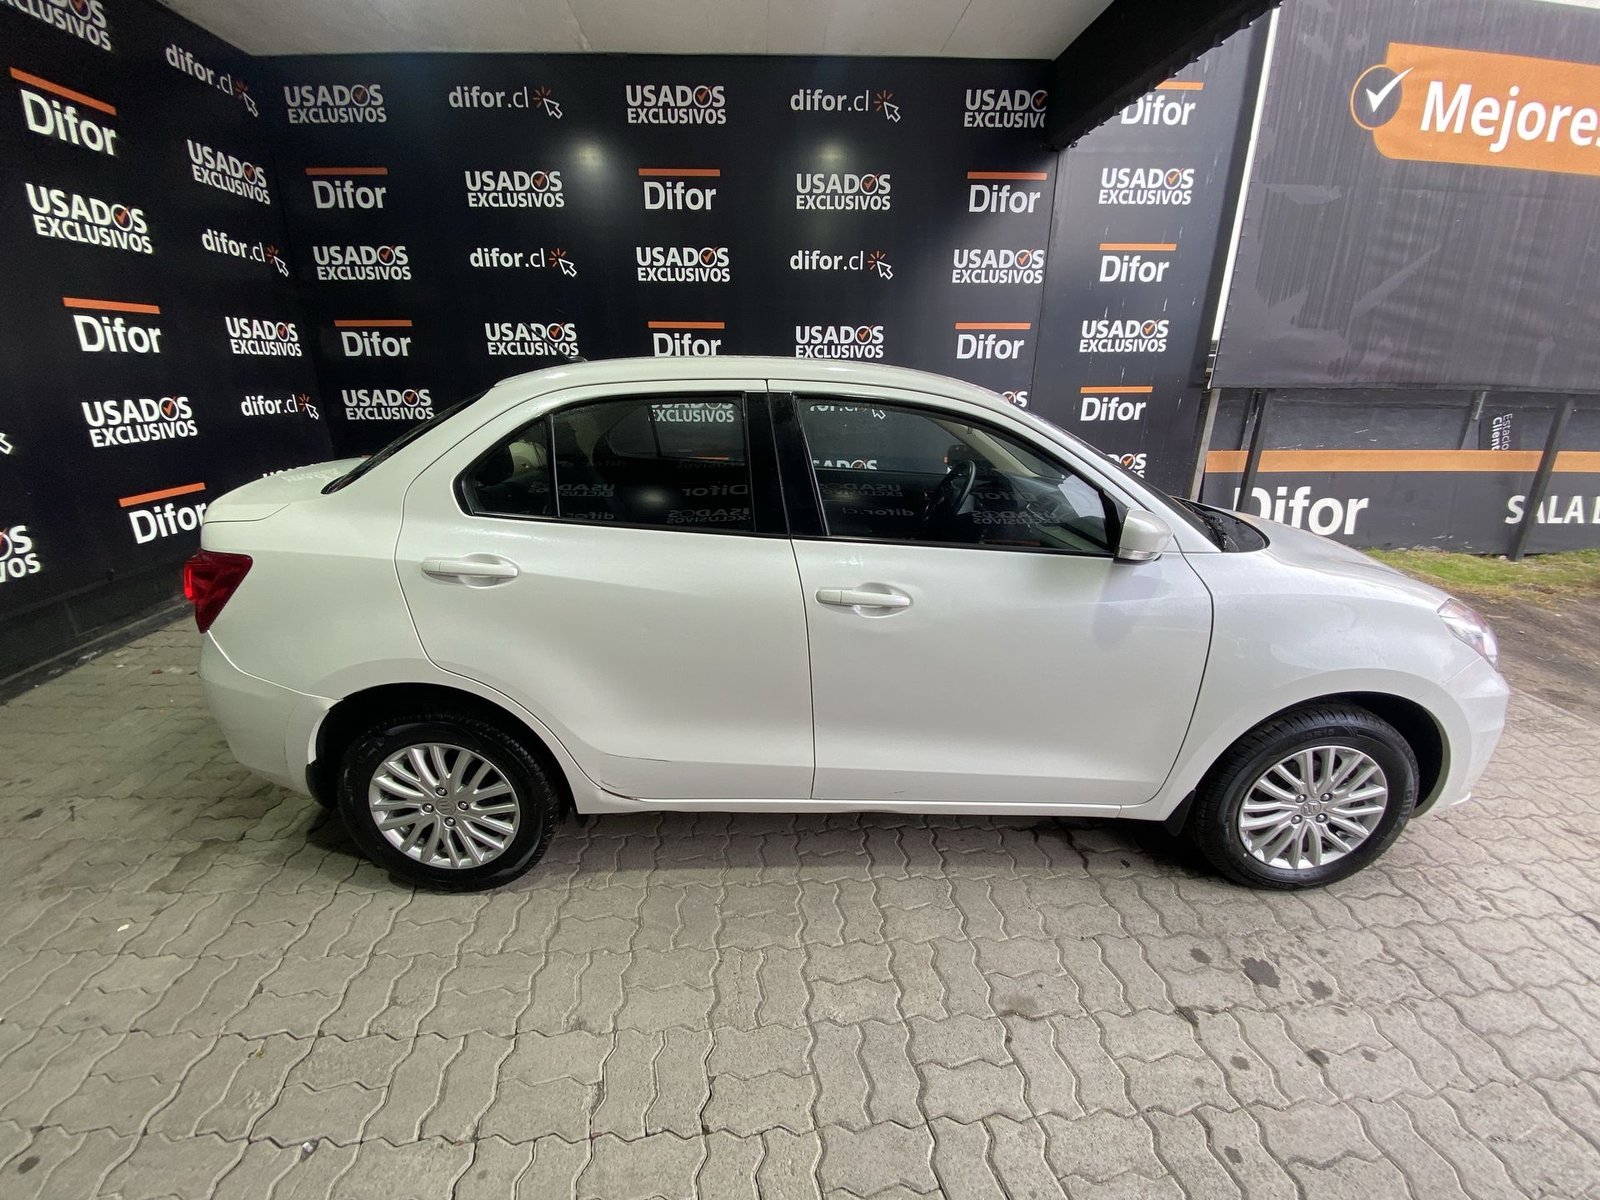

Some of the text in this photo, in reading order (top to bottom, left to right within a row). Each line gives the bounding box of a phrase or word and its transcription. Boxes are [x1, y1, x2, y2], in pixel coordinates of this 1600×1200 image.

[0, 0, 112, 51] CLUSIVOS
[165, 44, 233, 96] difor.cl
[283, 83, 384, 107] USADOS
[448, 86, 530, 109] difor.cl
[625, 84, 726, 108] USADOS
[790, 89, 870, 112] difor.cl
[965, 89, 1048, 112] USADO
[287, 106, 388, 124] EXCLUSIVOS
[627, 107, 727, 125] EXCLUSIVOS
[963, 111, 1046, 128] EXCLUSIV
[1119, 94, 1197, 126] Difor
[1420, 80, 1600, 153] Mejore
[20, 89, 118, 156] Difor
[187, 139, 268, 188] USADOS
[191, 164, 271, 206] EXCLUSIVOS
[465, 169, 563, 192] USADOS
[796, 172, 892, 195] USADOS
[1101, 166, 1195, 190] USADOS
[312, 181, 388, 209] Difor
[467, 191, 565, 208] EXCLUSIVOS
[643, 181, 717, 210] Difor
[796, 194, 891, 211] EXCLUSIVOS
[968, 184, 1041, 213] Difor
[1098, 189, 1193, 206] EXCLUSIVOS
[25, 183, 149, 235] USADOS
[32, 213, 154, 255] EXCLUSIVOS
[201, 228, 267, 264] difor.cl
[312, 244, 409, 266] USADOS
[469, 247, 546, 268] difor.cl
[635, 246, 730, 267] USADOS
[789, 249, 865, 271] difor.cl
[953, 248, 1045, 270] USADOS
[1099, 254, 1170, 283] Difor
[316, 265, 412, 281] EXCLUSIVOS
[636, 266, 731, 283] EXCLUSIVOS
[951, 269, 1043, 285] EXCLUSIVOS
[72, 314, 162, 354] Difor
[224, 316, 299, 343] USADOS
[485, 322, 577, 342] USADOS
[795, 325, 885, 345] USADOS
[1081, 318, 1170, 339] USADOS
[230, 338, 303, 358] EXCLUSIVOS
[340, 331, 412, 357] Difor
[487, 341, 580, 356] EXCLUSIVOS
[652, 332, 722, 357] Difor
[795, 344, 884, 359] EXCLUSIVOS
[956, 333, 1025, 360] Difor
[1078, 338, 1167, 353] EXCLUSIVOS
[240, 393, 299, 418] difor.cl
[341, 388, 434, 407] USADOS
[1080, 396, 1148, 422] Difor
[82, 396, 194, 427] USADOS
[345, 406, 436, 421] EXCLUSIVOS
[89, 419, 199, 448] EXCLUSIVOS
[128, 502, 206, 545] Difor
